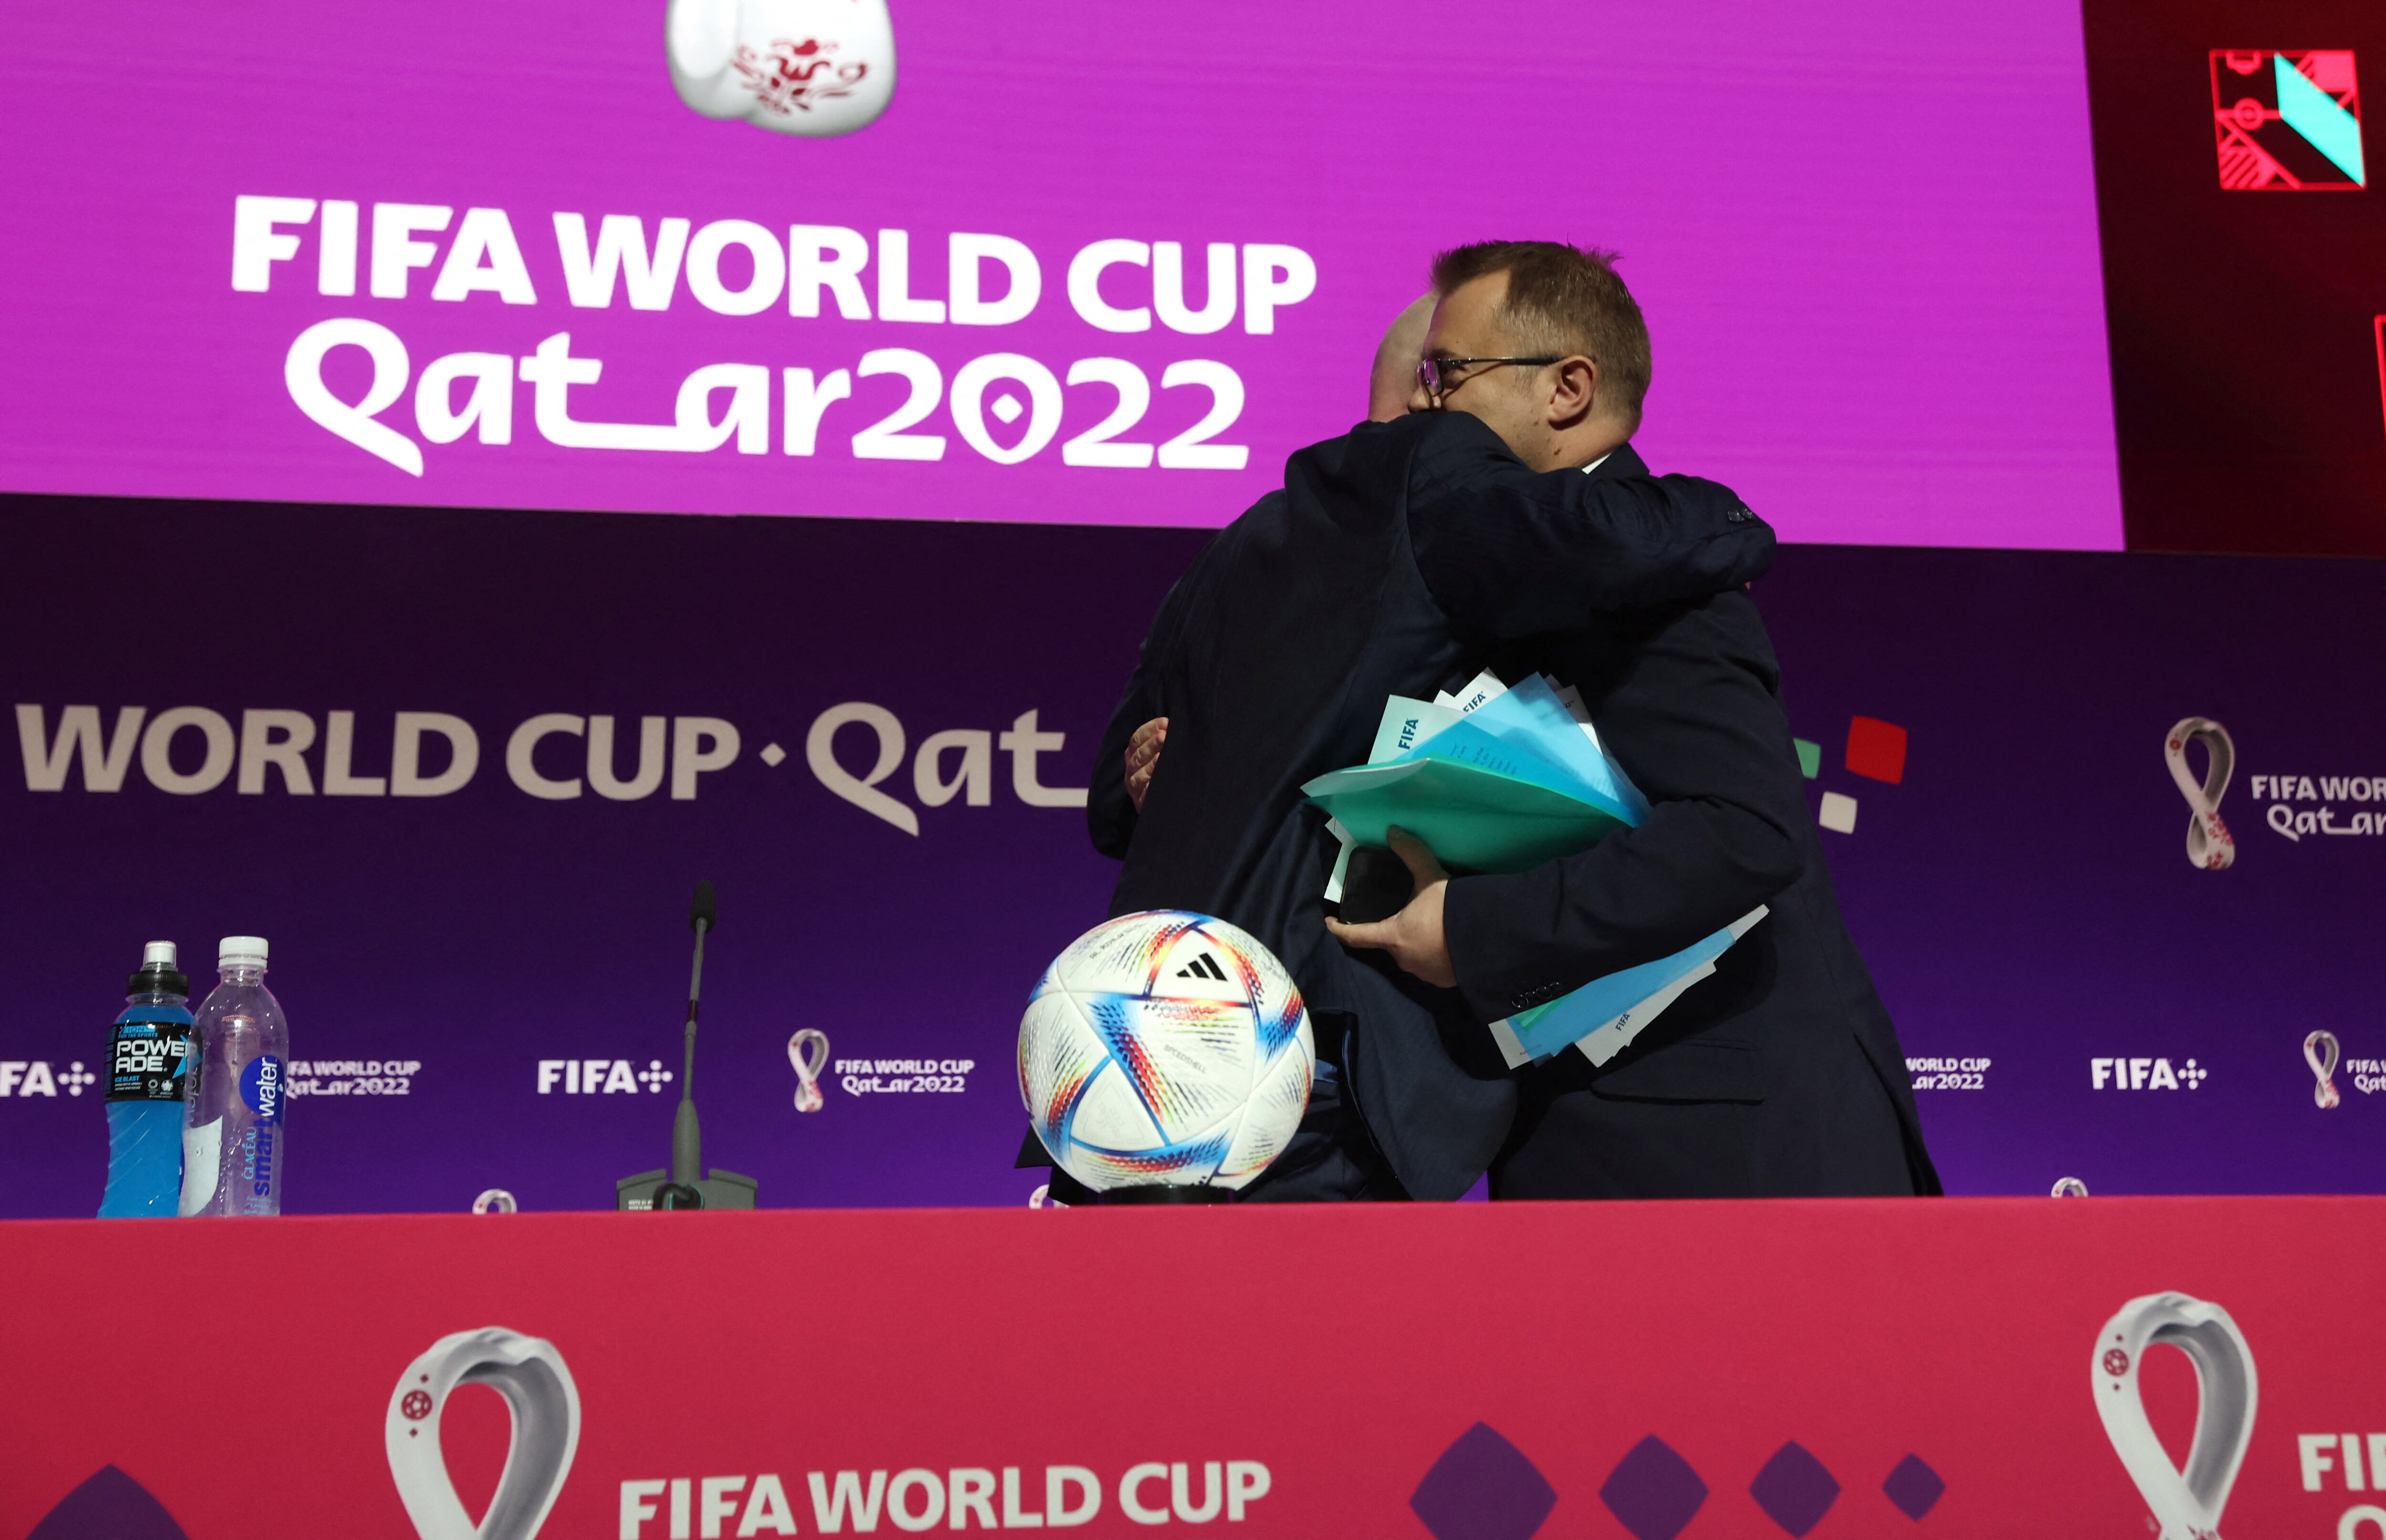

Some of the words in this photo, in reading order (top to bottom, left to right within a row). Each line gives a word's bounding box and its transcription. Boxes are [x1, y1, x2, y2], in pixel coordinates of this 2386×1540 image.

[231, 195, 538, 305] FIFA
[552, 211, 1042, 326] WORLD
[1067, 238, 1317, 335] CUP
[284, 317, 1249, 478] Qatar2022
[1463, 691, 1486, 713] FIFA
[1398, 718, 1419, 750] FIFA
[16, 704, 479, 797] WORLD
[506, 713, 741, 801] CUP
[2251, 775, 2318, 800] FIFA
[1615, 1014, 1630, 1031] FIFA
[313, 1061, 381, 1076] WORLD
[383, 1061, 421, 1076] CUP
[835, 1059, 874, 1074] FIFA
[874, 1059, 939, 1074] WORLD
[940, 1059, 975, 1074] CUP
[1905, 1057, 1958, 1072] WORLD
[1959, 1058, 1992, 1072] CUP
[2346, 1059, 2381, 1074] FIFA
[841, 1075, 966, 1097] Qatar2022
[1912, 1073, 1985, 1090] ar2022
[619, 1474, 797, 1540] FIFA
[806, 1465, 1102, 1533] WORLD
[1119, 1460, 1271, 1525] CUP
